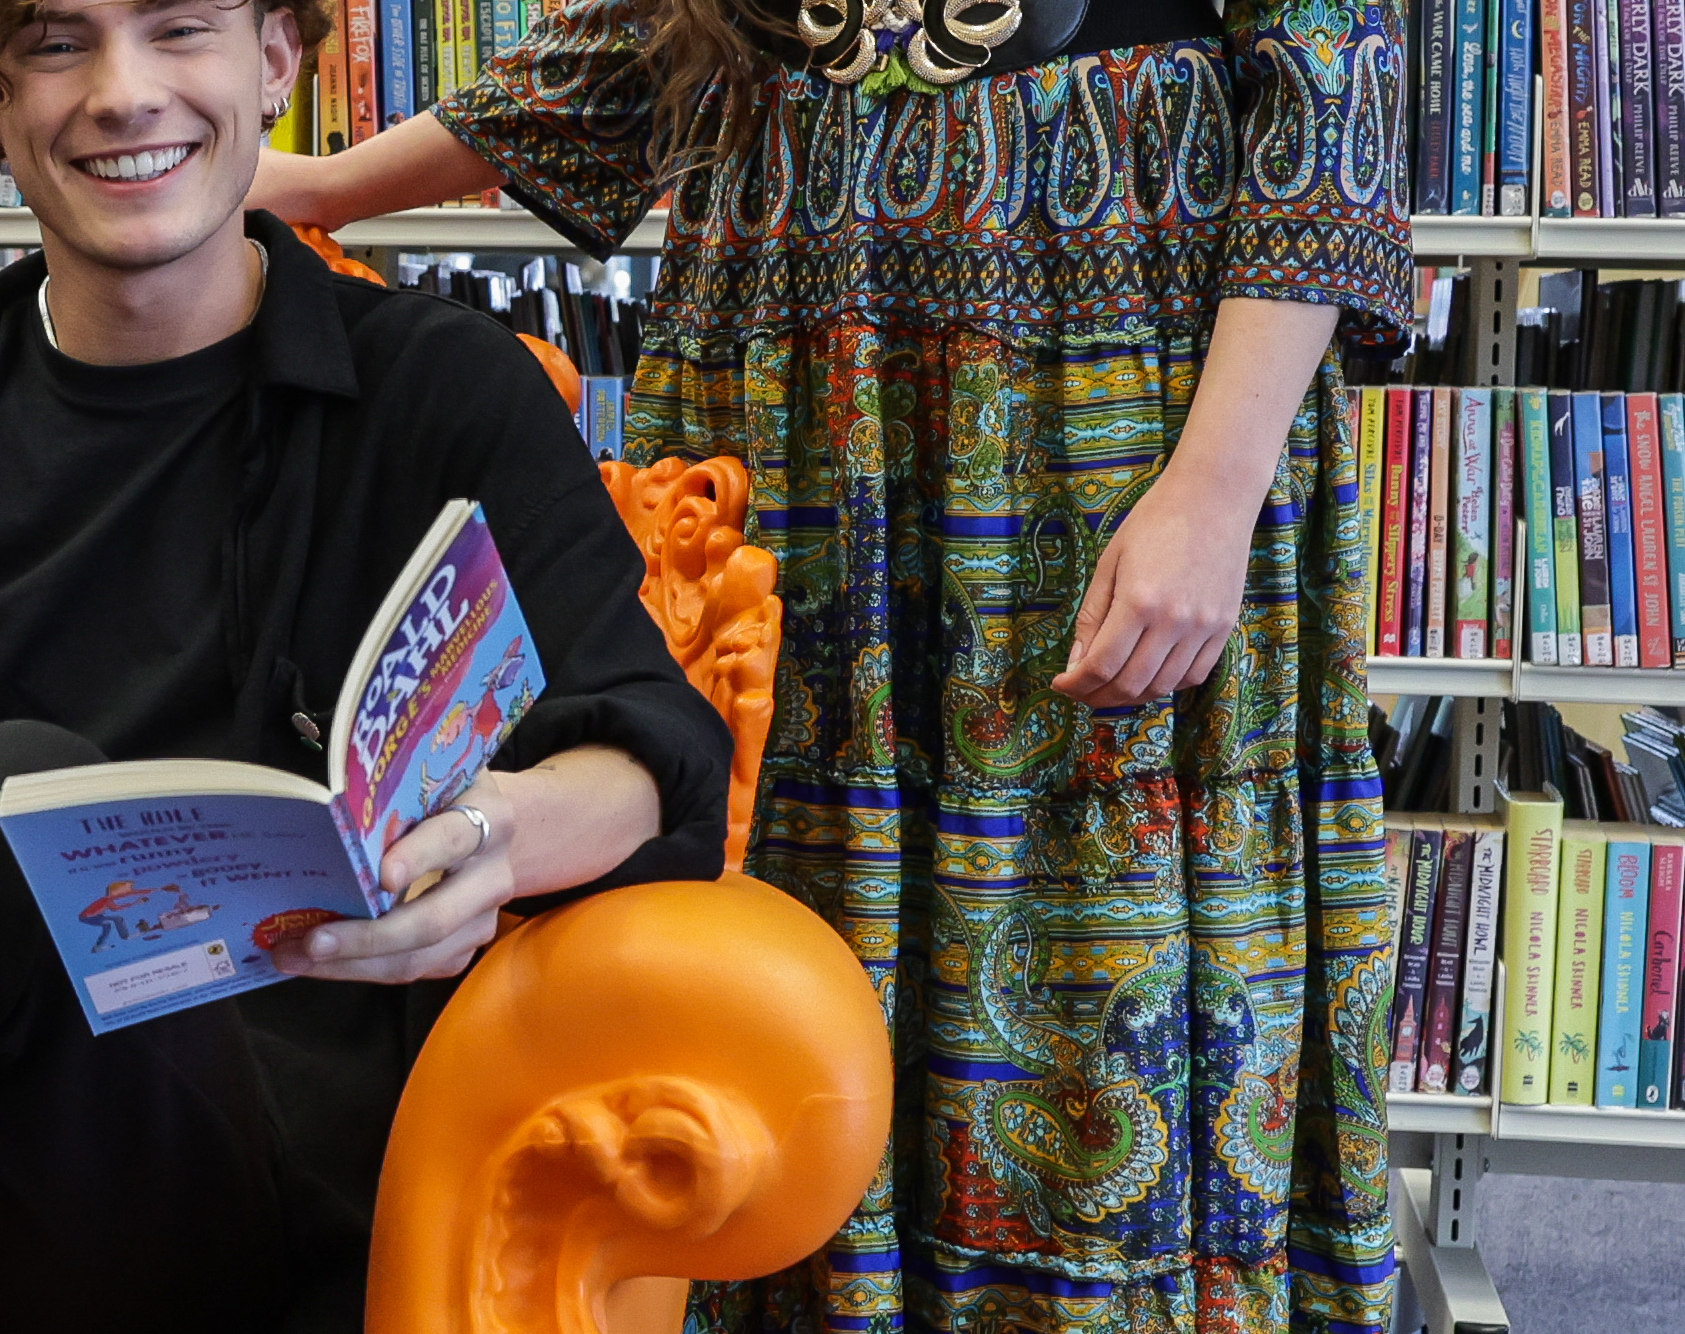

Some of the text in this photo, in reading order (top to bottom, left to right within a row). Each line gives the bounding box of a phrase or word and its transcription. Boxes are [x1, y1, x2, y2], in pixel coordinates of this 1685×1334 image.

[349, 5, 371, 63] FIREFOX
[1428, 11, 1445, 41] WAR
[1572, 26, 1591, 45] THE
[1430, 42, 1443, 77] CAME
[1574, 43, 1591, 105] MIGHTY
[1632, 42, 1650, 96] DARK
[1667, 43, 1685, 98] DARK
[1429, 81, 1441, 115] HOME
[1460, 128, 1475, 153] and
[1549, 120, 1564, 188] EMMA READ
[1577, 121, 1592, 188] EMMA READ
[1633, 103, 1645, 174] PHILIP REEVE
[1667, 104, 1680, 176] PHILIP REEVE
[1365, 418, 1375, 460] PERCIVAL
[1465, 395, 1485, 486] Anna War
[1580, 479, 1595, 511] tale
[1433, 514, 1445, 543] D-DAY
[1582, 528, 1595, 560] JOHN
[1592, 517, 1604, 560] LAUREN
[1636, 434, 1659, 627] SNOW ANGEL LAUREN JOHN
[1383, 523, 1401, 623] Slippery Stress
[430, 578, 499, 677] MARVELLOUS
[441, 606, 492, 676] MEDICINE
[352, 563, 457, 766] ROALD
[359, 598, 471, 783] DAHL
[61, 830, 227, 861] WHATEVER
[1525, 828, 1553, 897] STARBOARD
[1616, 855, 1640, 899] BLOOM
[1409, 859, 1434, 946] MIDNIGHT HOUR
[1473, 865, 1495, 956] MIDNIGHT HOWL
[1524, 912, 1545, 1017] NICOLA SKINNER
[1569, 908, 1589, 1010] NICOLA SKINNER
[1615, 911, 1636, 1014] NICOLA SKINNER
[1649, 930, 1674, 996] Carbonel
